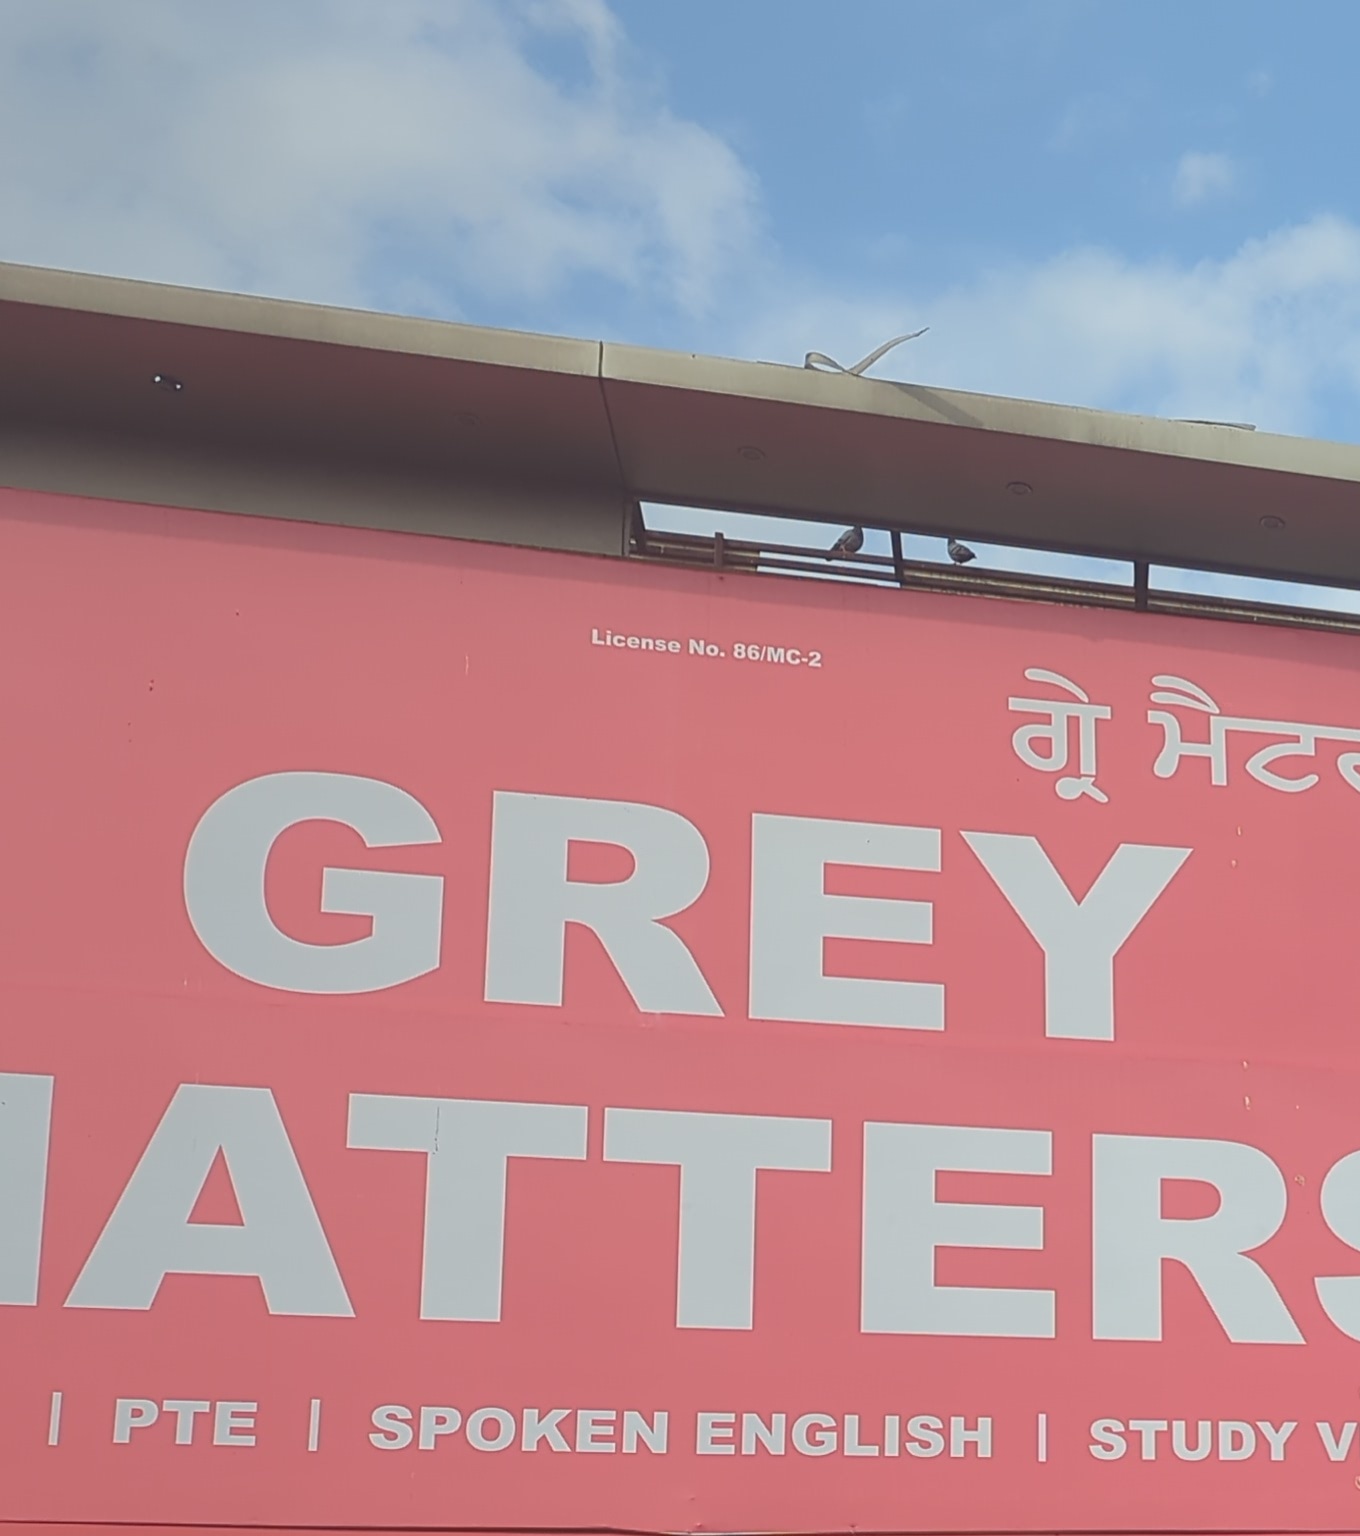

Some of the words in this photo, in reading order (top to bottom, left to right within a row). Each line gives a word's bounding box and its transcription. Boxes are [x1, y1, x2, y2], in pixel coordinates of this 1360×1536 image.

[590, 628, 681, 653] License
[688, 639, 725, 657] No.
[733, 643, 822, 667] 86/MC-2
[183, 770, 1193, 1042] GREY
[112, 1398, 259, 1446] PTE
[368, 1405, 669, 1454] SPOKEN
[695, 1413, 993, 1459] ENGLISH
[1088, 1415, 1298, 1463] STUDY
